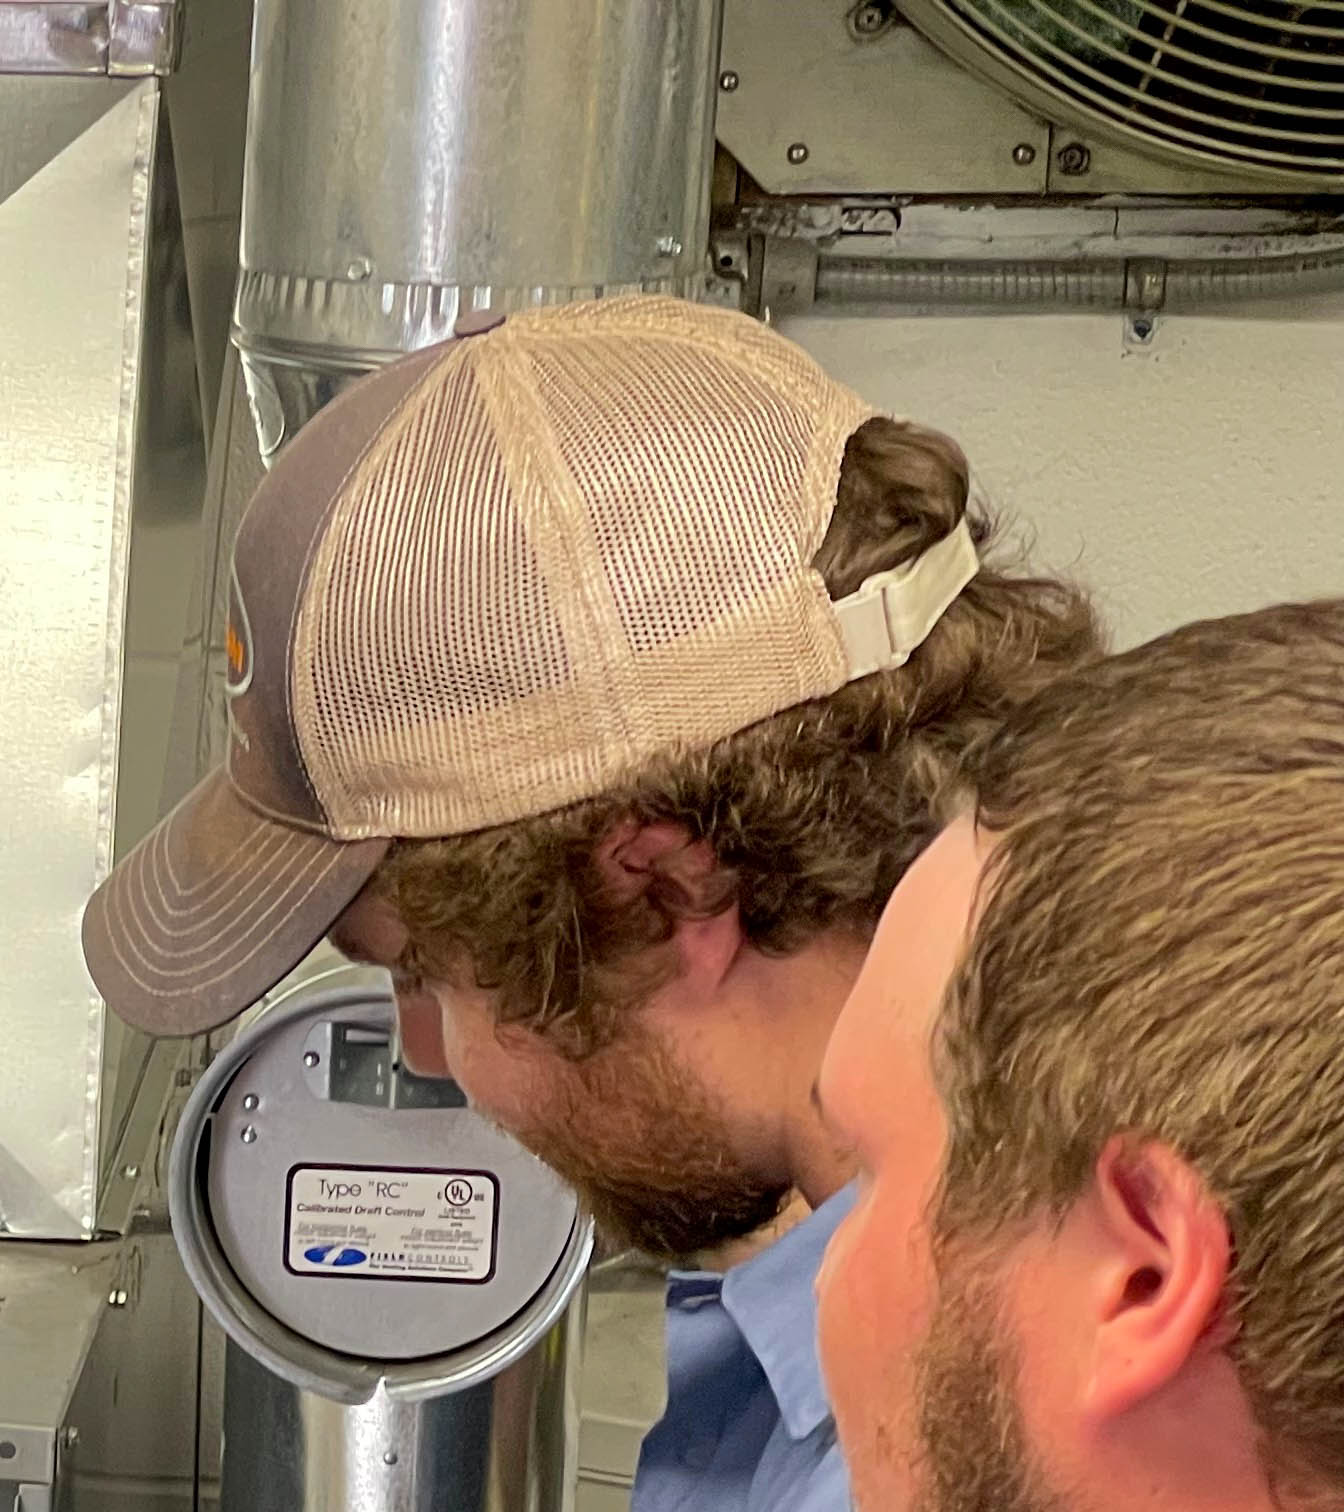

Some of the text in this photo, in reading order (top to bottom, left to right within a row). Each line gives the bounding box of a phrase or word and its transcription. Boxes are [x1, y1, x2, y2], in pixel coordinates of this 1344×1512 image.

[319, 1179, 362, 1199] Type
[296, 1203, 352, 1214] Calibrated
[354, 1206, 382, 1216] Draft
[385, 1207, 426, 1218] Control
